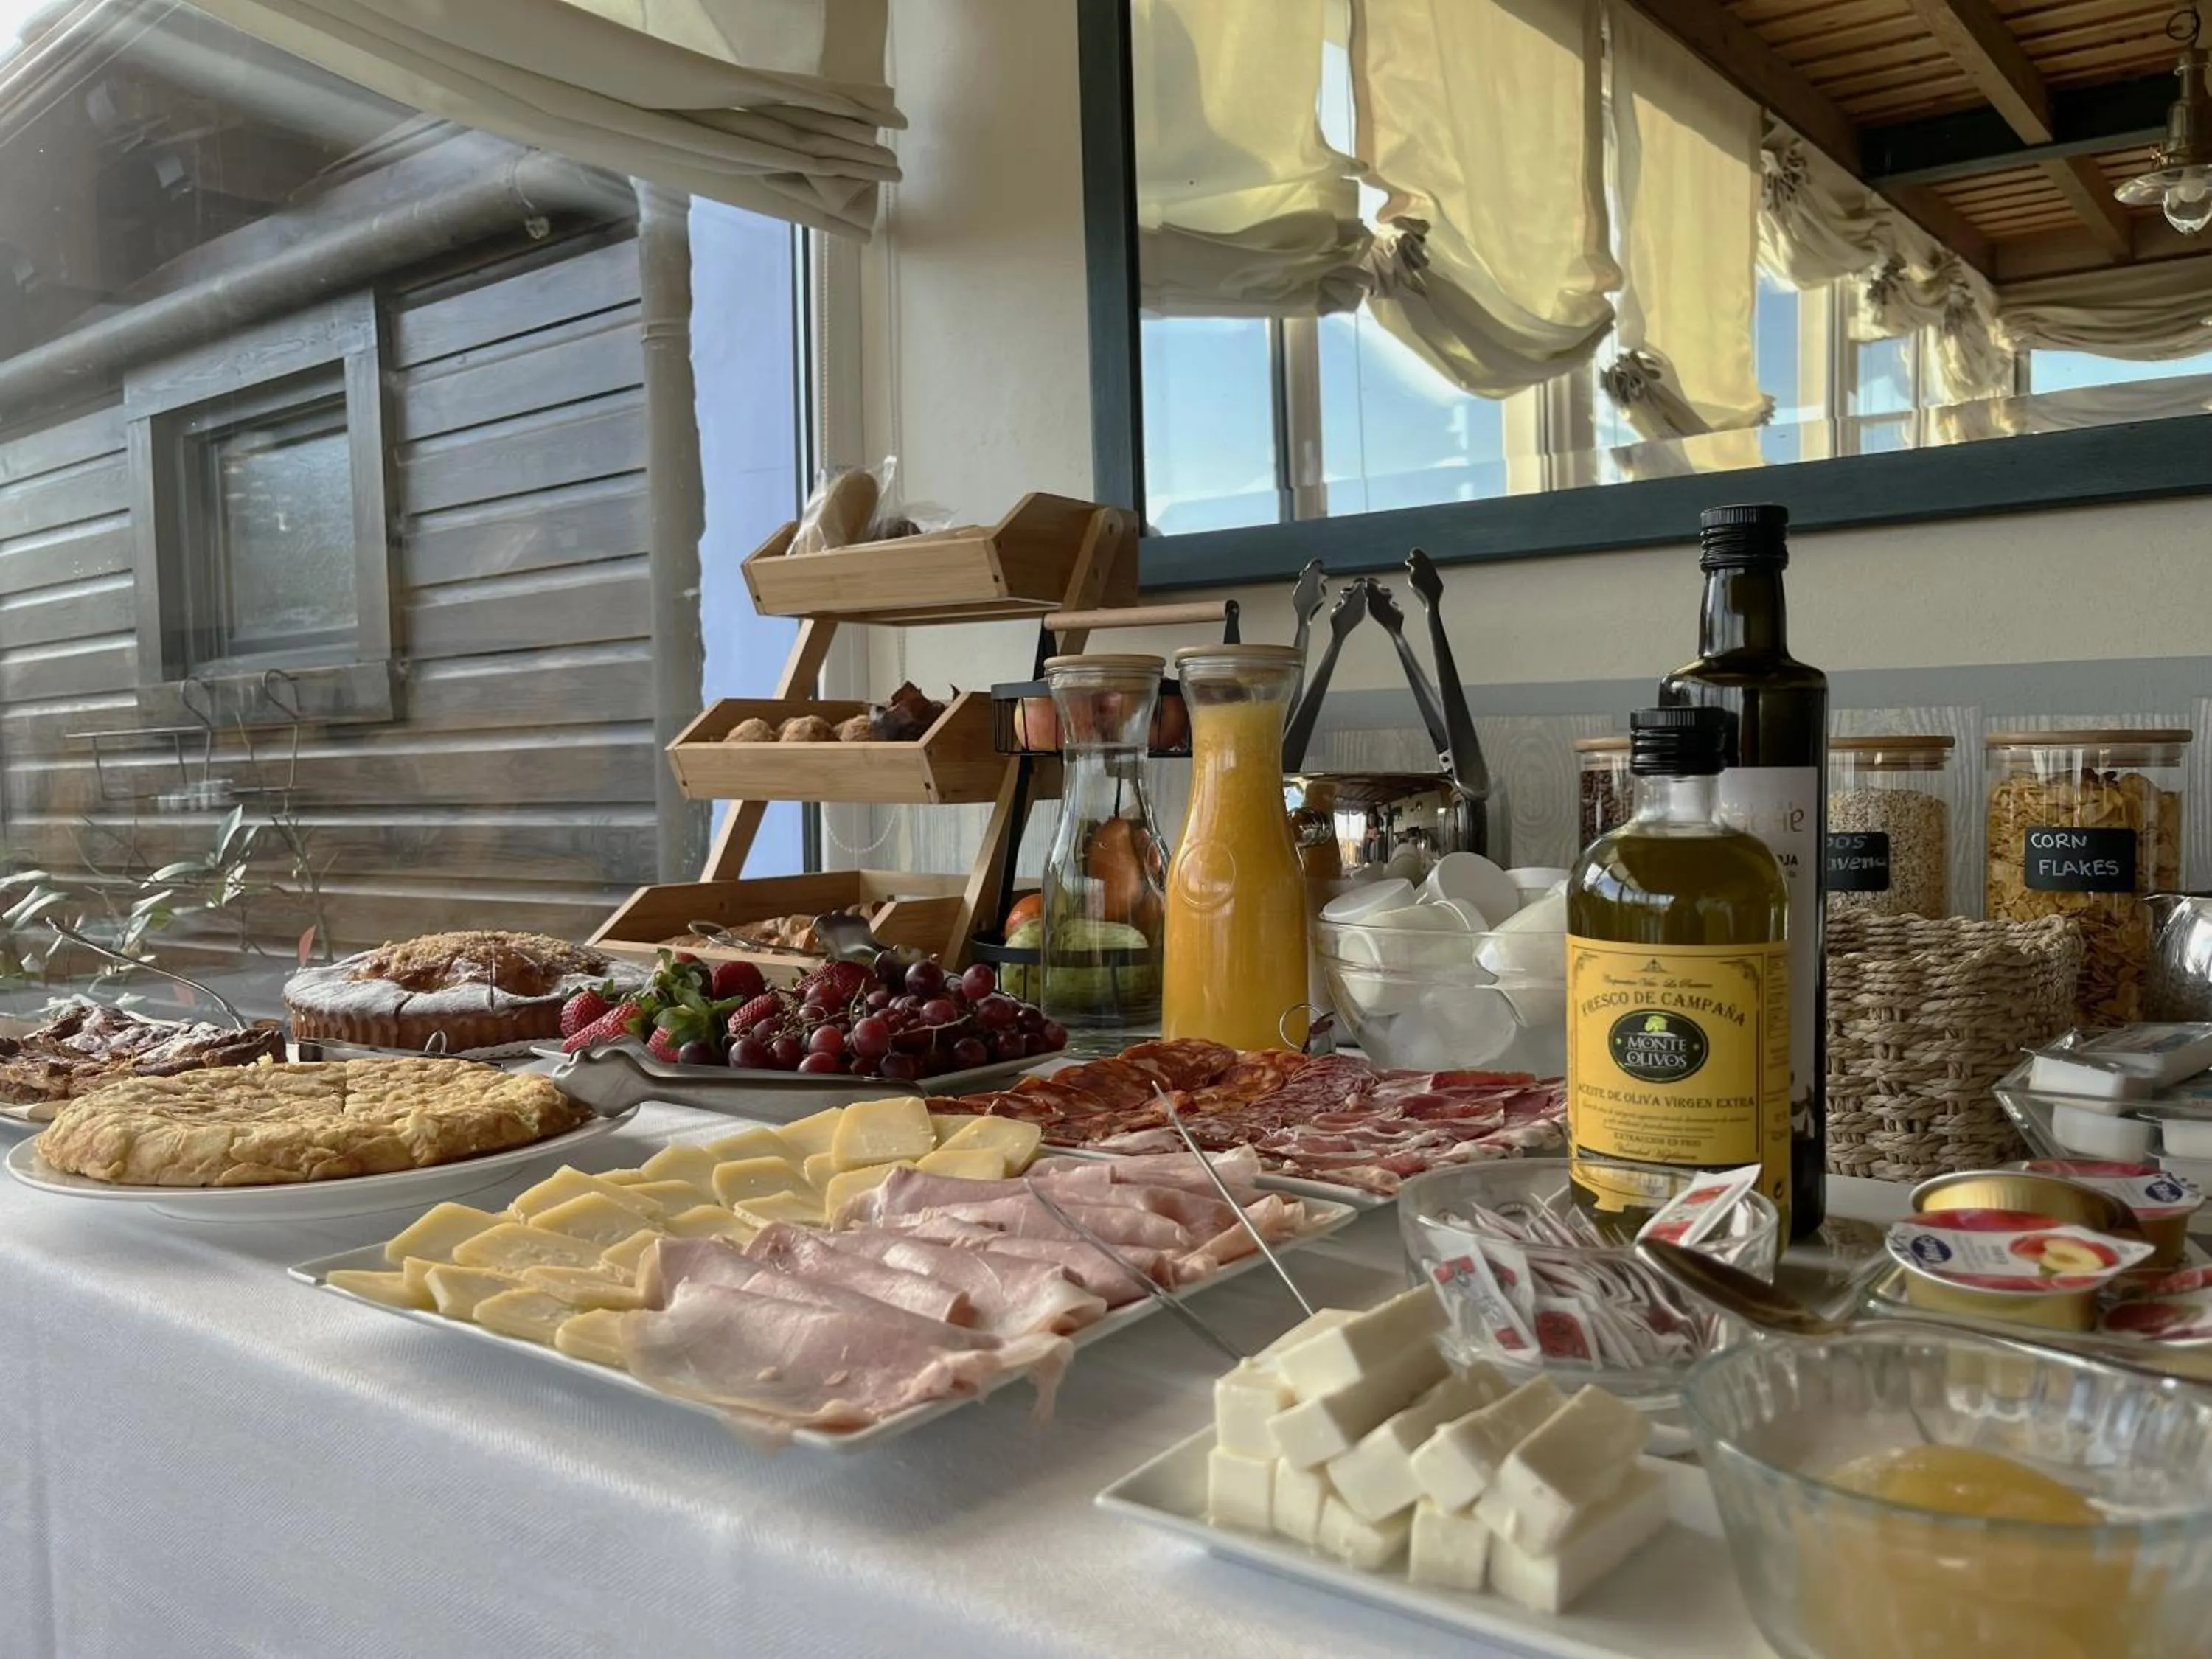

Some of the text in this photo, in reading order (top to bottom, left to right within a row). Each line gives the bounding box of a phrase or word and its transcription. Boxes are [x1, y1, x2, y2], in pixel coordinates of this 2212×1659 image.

[2030, 832, 2087, 849] CORN
[2038, 859, 2120, 877] FLAKES
[1581, 990, 1746, 1027] FRESCO DE CAMPAÑA
[1626, 1036, 1687, 1051] MONTE
[1625, 1051, 1687, 1068] OLIVOS
[1607, 1089, 1624, 1102] DE
[1624, 1091, 1660, 1106] OLIVA
[1664, 1096, 1712, 1108] VIRGEN
[1716, 1096, 1755, 1108] EXTRA
